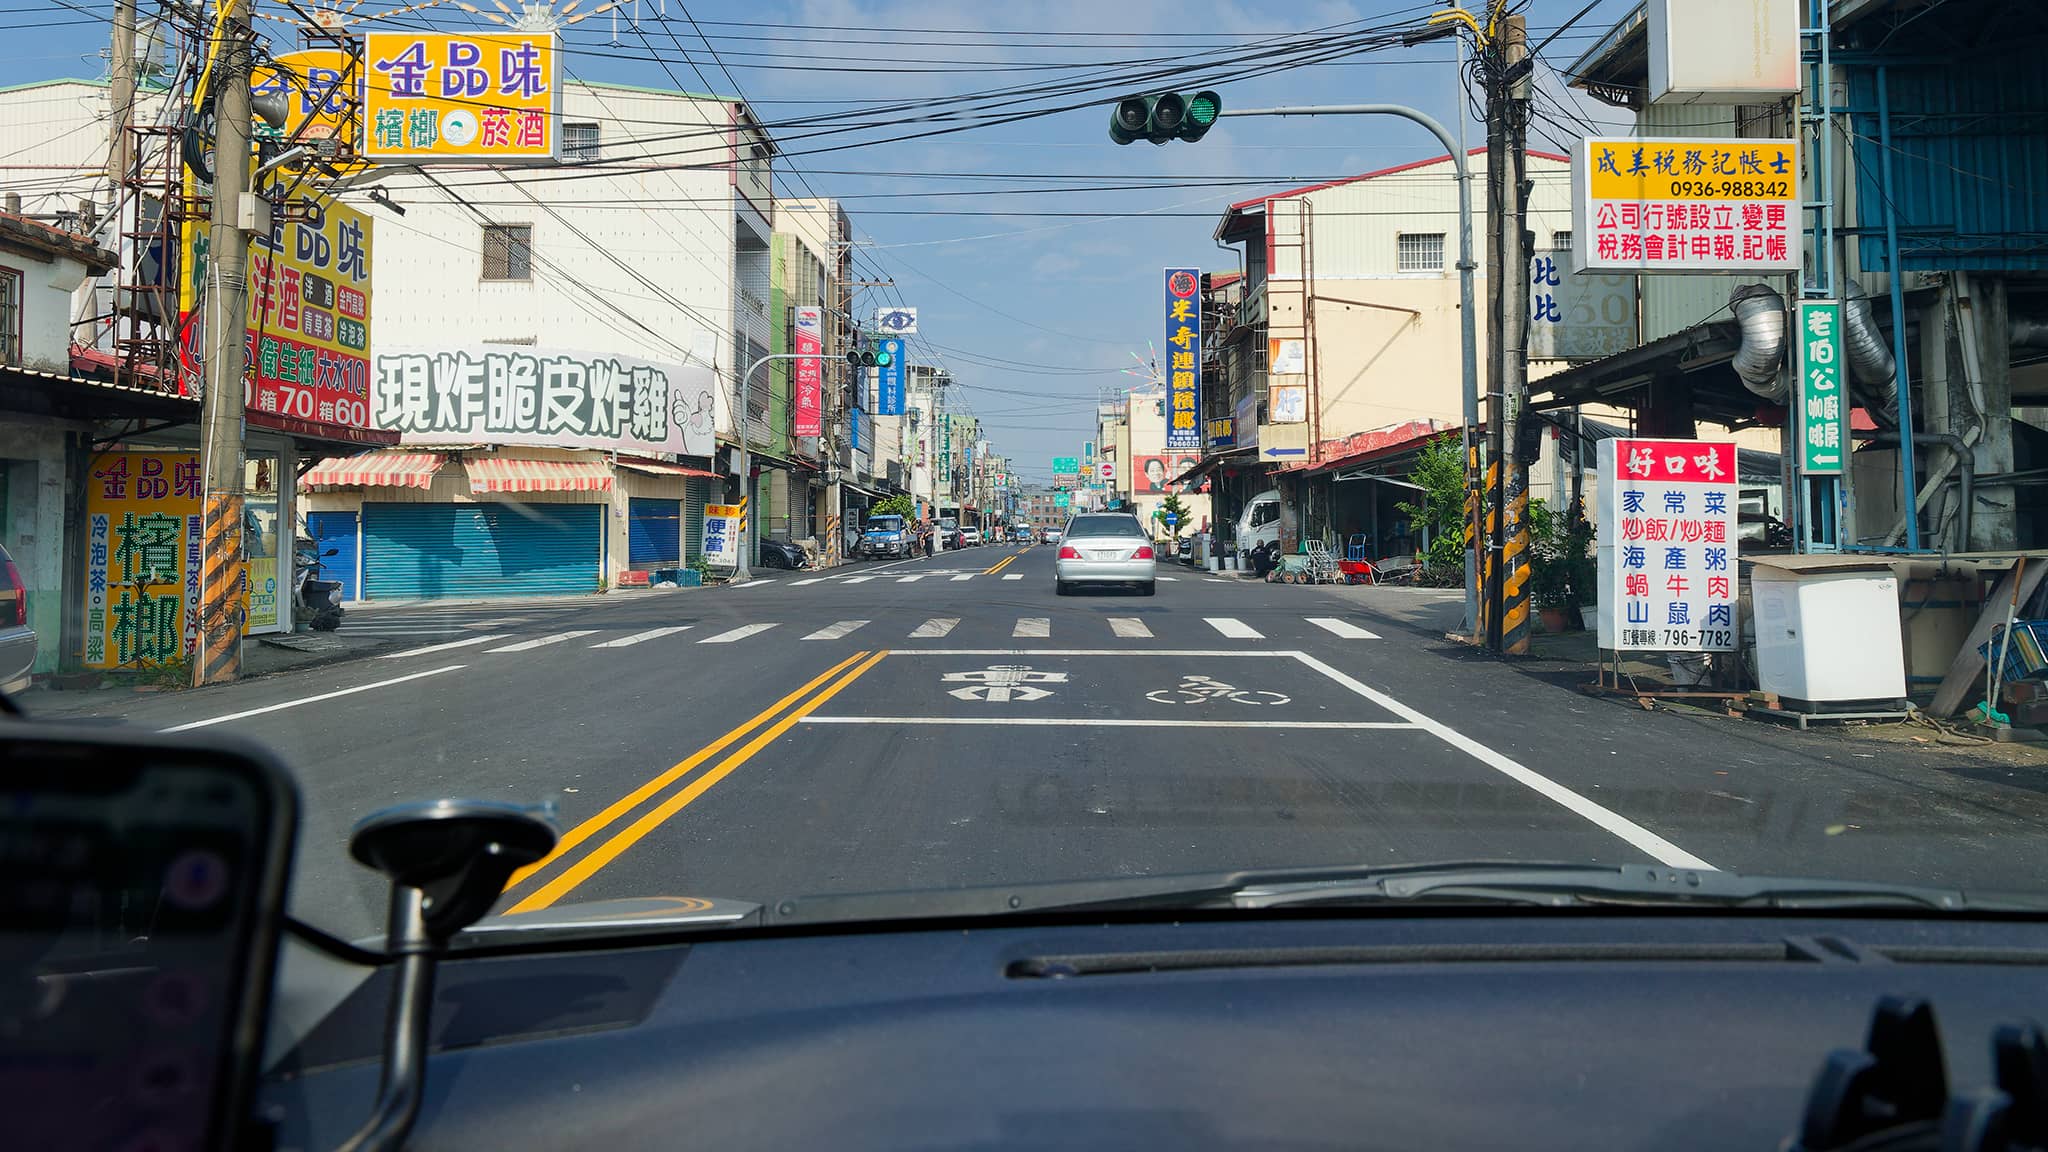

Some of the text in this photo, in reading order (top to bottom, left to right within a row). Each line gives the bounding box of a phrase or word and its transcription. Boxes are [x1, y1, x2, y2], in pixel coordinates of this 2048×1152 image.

[375, 42, 547, 98] 金品味
[374, 109, 438, 149] 檳榔
[481, 107, 545, 147] 菸酒
[1597, 147, 1791, 179] 成美稅務記帳士
[1670, 181, 1788, 197] 0936-988342
[1597, 203, 1787, 231] 公司行號設立.變更
[1597, 233, 1787, 262] 稅務會計申報.記帳
[251, 255, 300, 333] 洋酒
[260, 336, 317, 388] 衛生紙
[1169, 299, 1199, 430] 米奇連鎖檳榔
[1808, 310, 1836, 391] 老伯公
[375, 351, 669, 441] 現炸脆皮炸雞
[94, 456, 201, 499] 金品味
[1626, 447, 1726, 481] 好口味
[1622, 490, 1727, 515] 家常菜
[705, 518, 726, 553] 便當
[1622, 518, 1727, 543] 炒飯/炒麵
[1622, 545, 1727, 571] 海產粥
[112, 512, 182, 665] 檳榔
[1625, 573, 1729, 599] 蝸牛肉
[1627, 600, 1731, 627] 山鼠肉
[1663, 630, 1732, 647] 796-7782
